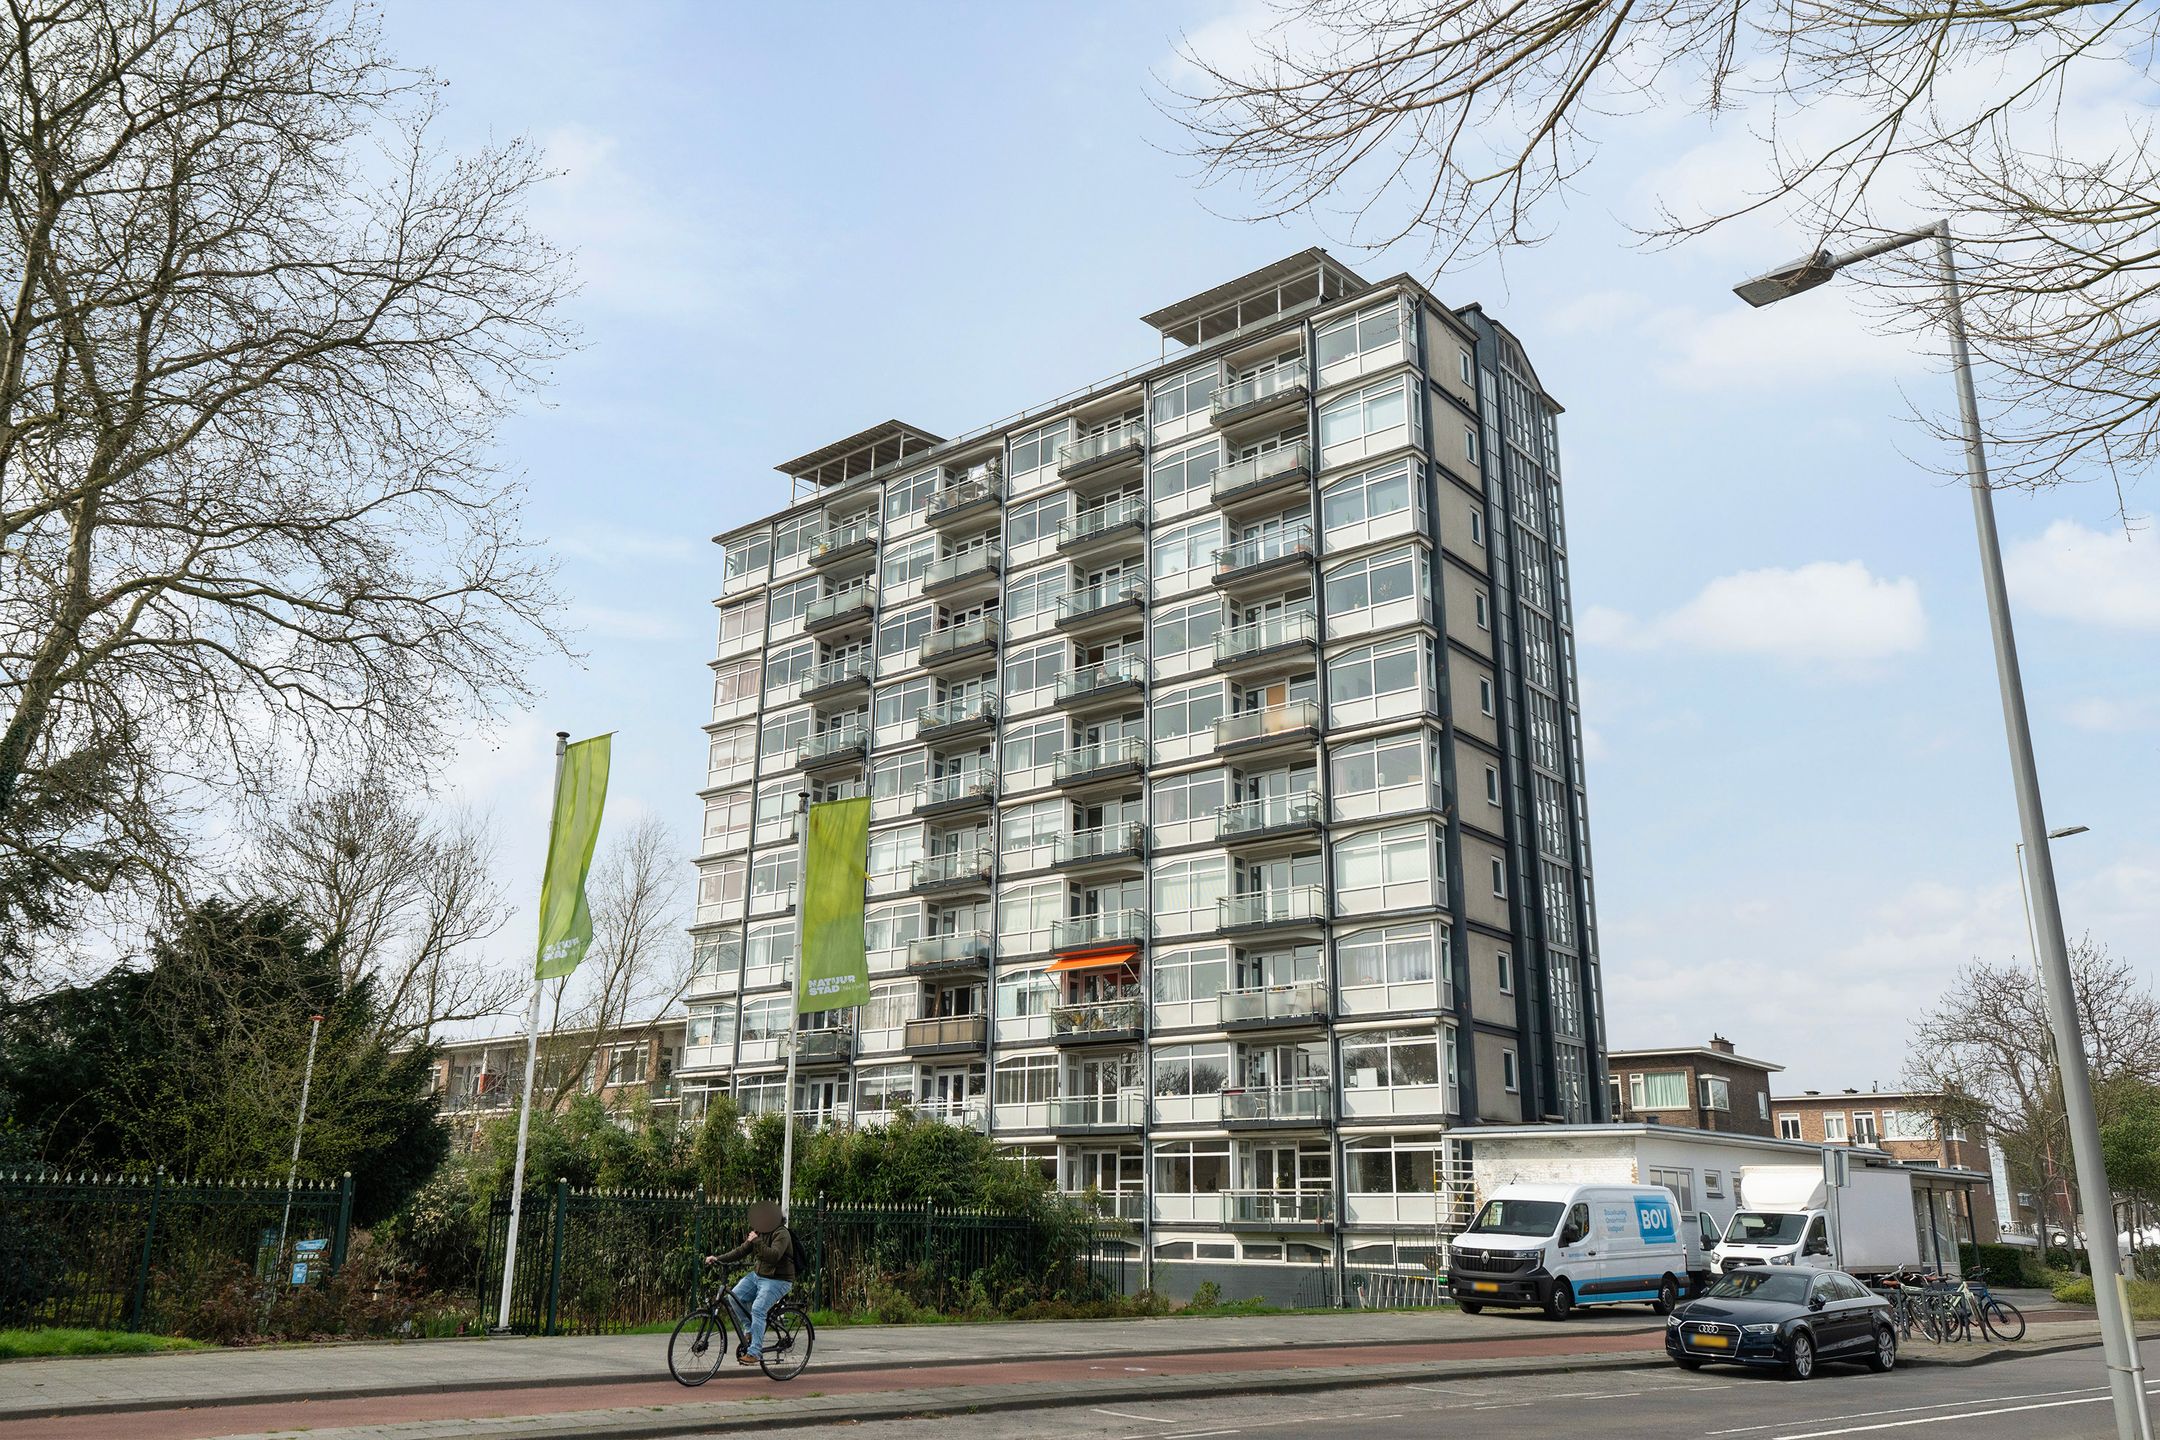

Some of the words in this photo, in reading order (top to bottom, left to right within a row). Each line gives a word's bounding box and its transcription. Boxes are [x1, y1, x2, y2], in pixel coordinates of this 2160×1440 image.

[808, 975, 856, 988] NATUUR
[809, 985, 840, 996] STAD
[1640, 1208, 1667, 1230] BOV
